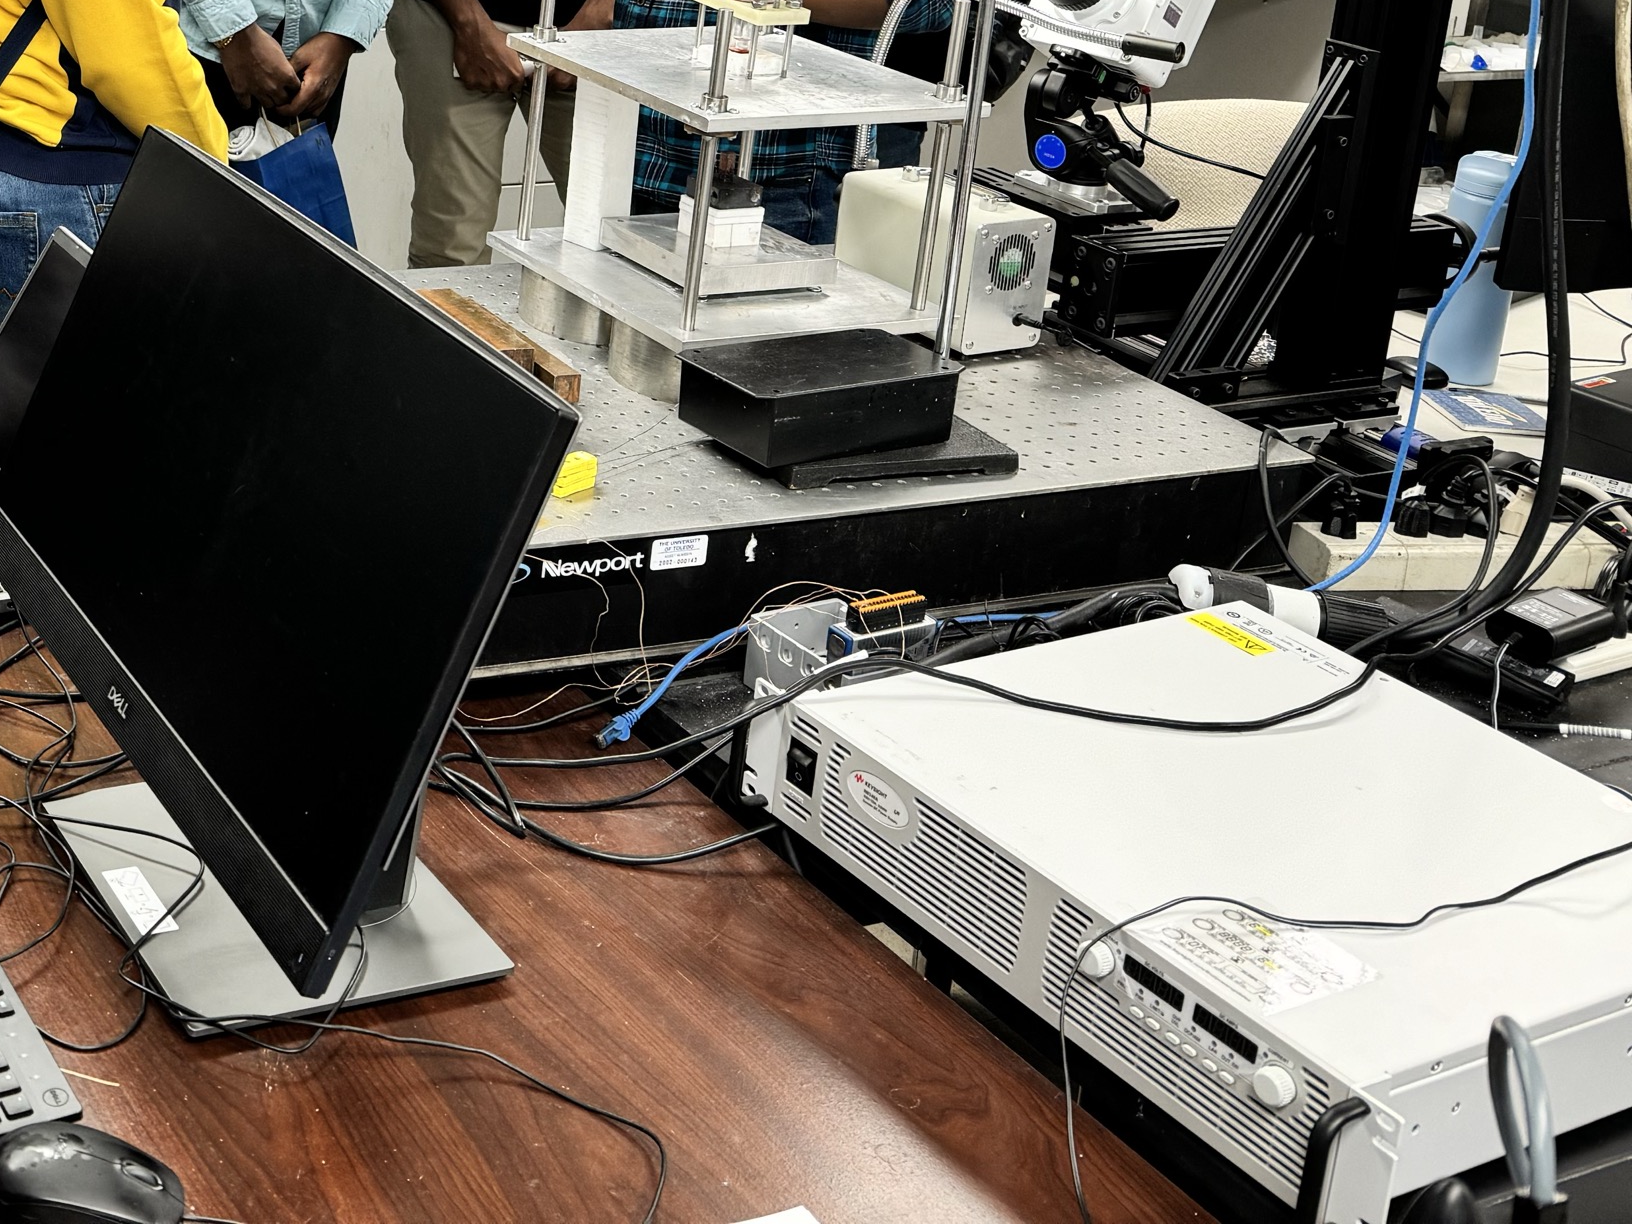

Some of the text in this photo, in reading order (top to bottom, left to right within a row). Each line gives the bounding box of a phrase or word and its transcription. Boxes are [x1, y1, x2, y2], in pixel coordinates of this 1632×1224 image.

[670, 537, 701, 546] UNIVERSITY
[673, 543, 695, 552] TOLEDO
[541, 551, 645, 578] Newport
[107, 685, 128, 720] DELL
[864, 781, 888, 799] KEYSIGHT
